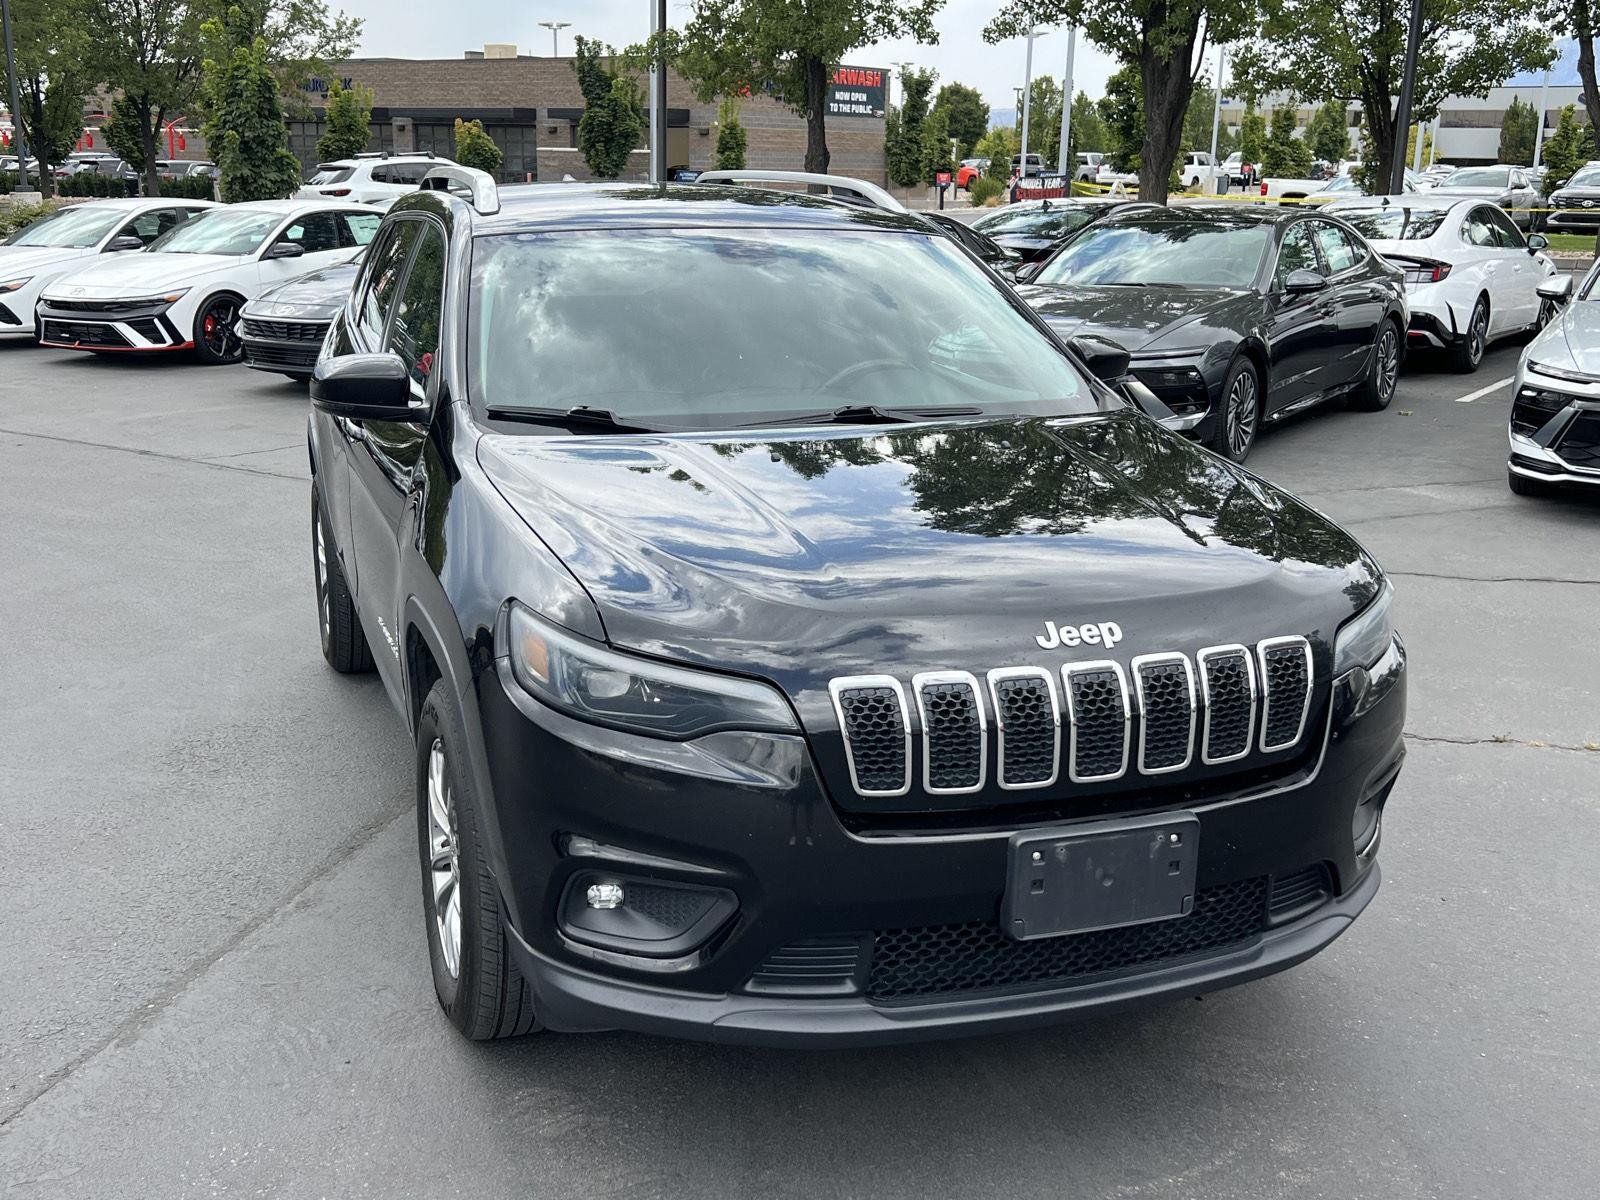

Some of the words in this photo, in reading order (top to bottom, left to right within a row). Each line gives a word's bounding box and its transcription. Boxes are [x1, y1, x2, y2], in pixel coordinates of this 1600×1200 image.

[827, 68, 881, 88] ARWASH
[835, 91, 850, 101] NOW
[851, 92, 867, 102] OPEN
[830, 103, 838, 112] TO
[839, 103, 851, 113] THE
[852, 104, 872, 114] PUBLIC
[1020, 178, 1043, 189] MODEL
[1044, 177, 1061, 189] YEAR
[1035, 620, 1122, 649] Jeep
